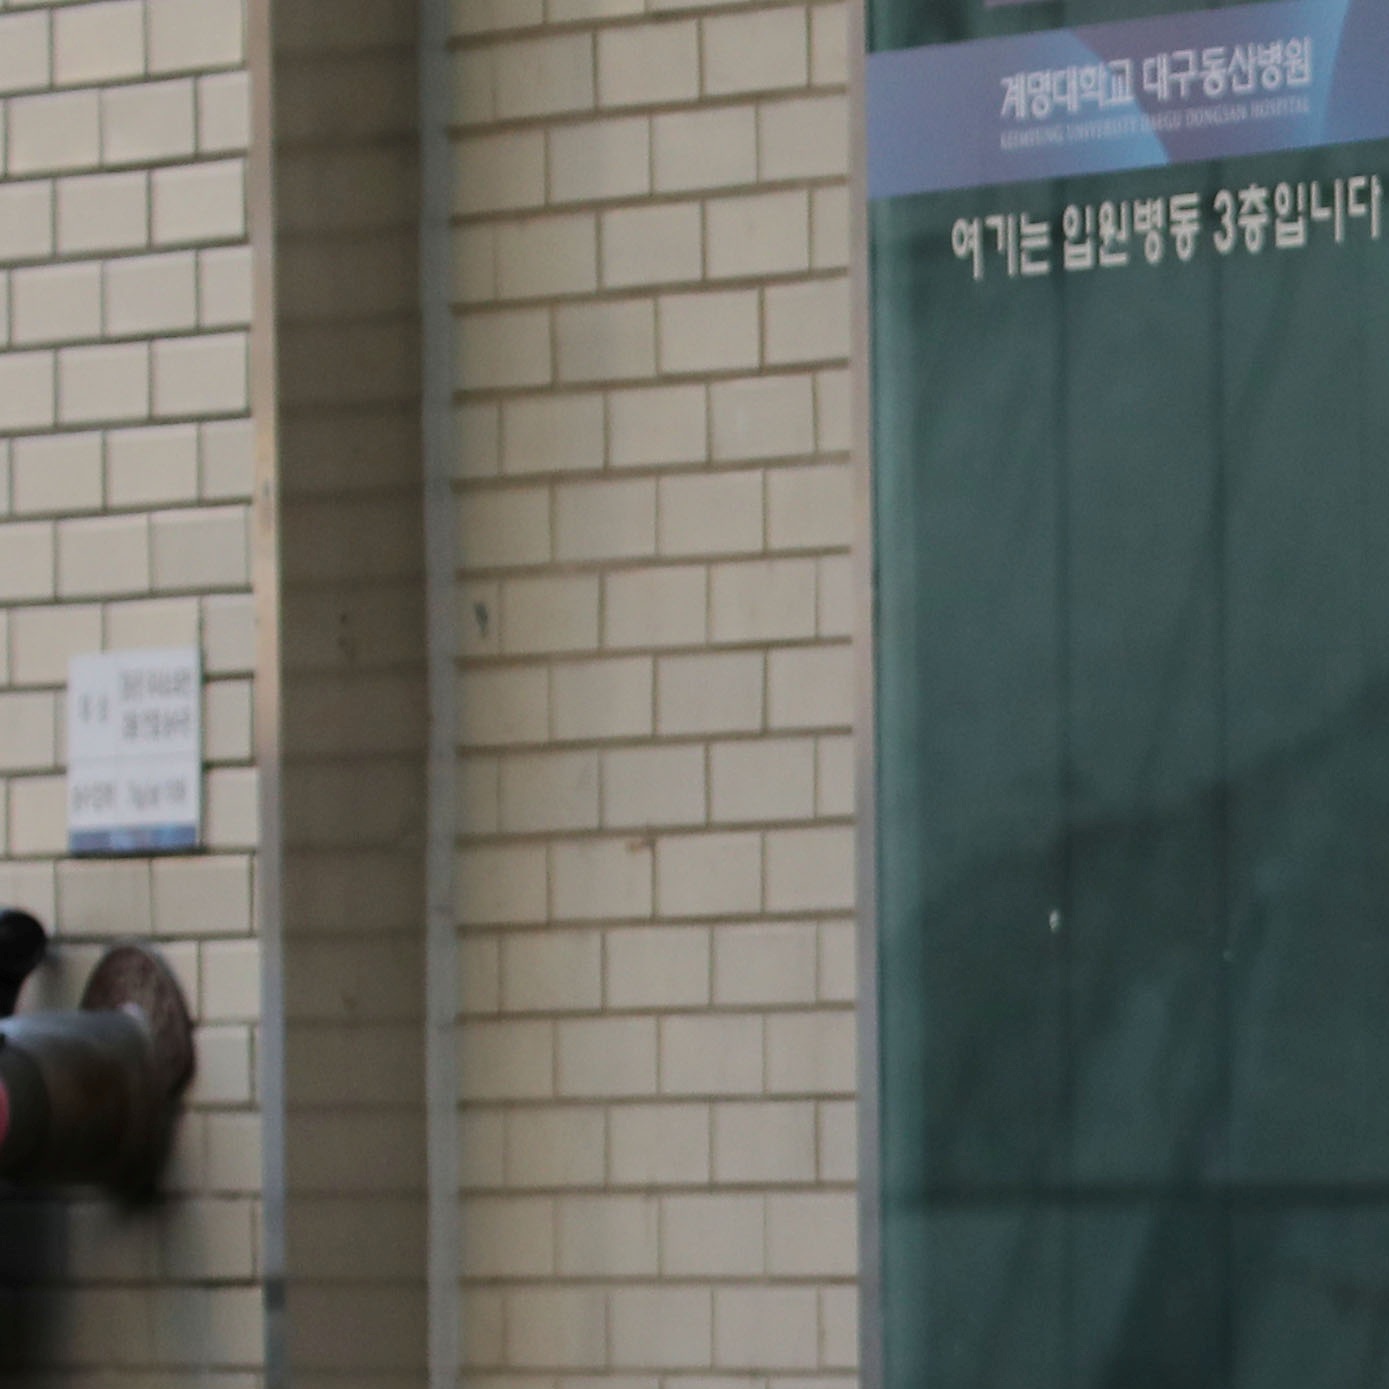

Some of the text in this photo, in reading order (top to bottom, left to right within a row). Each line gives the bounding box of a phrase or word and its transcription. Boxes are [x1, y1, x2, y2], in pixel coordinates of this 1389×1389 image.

[1000, 37, 1311, 119] 계명대학교 대구동산병원
[951, 174, 1382, 280] 여기는 입원병동 3층입니다
